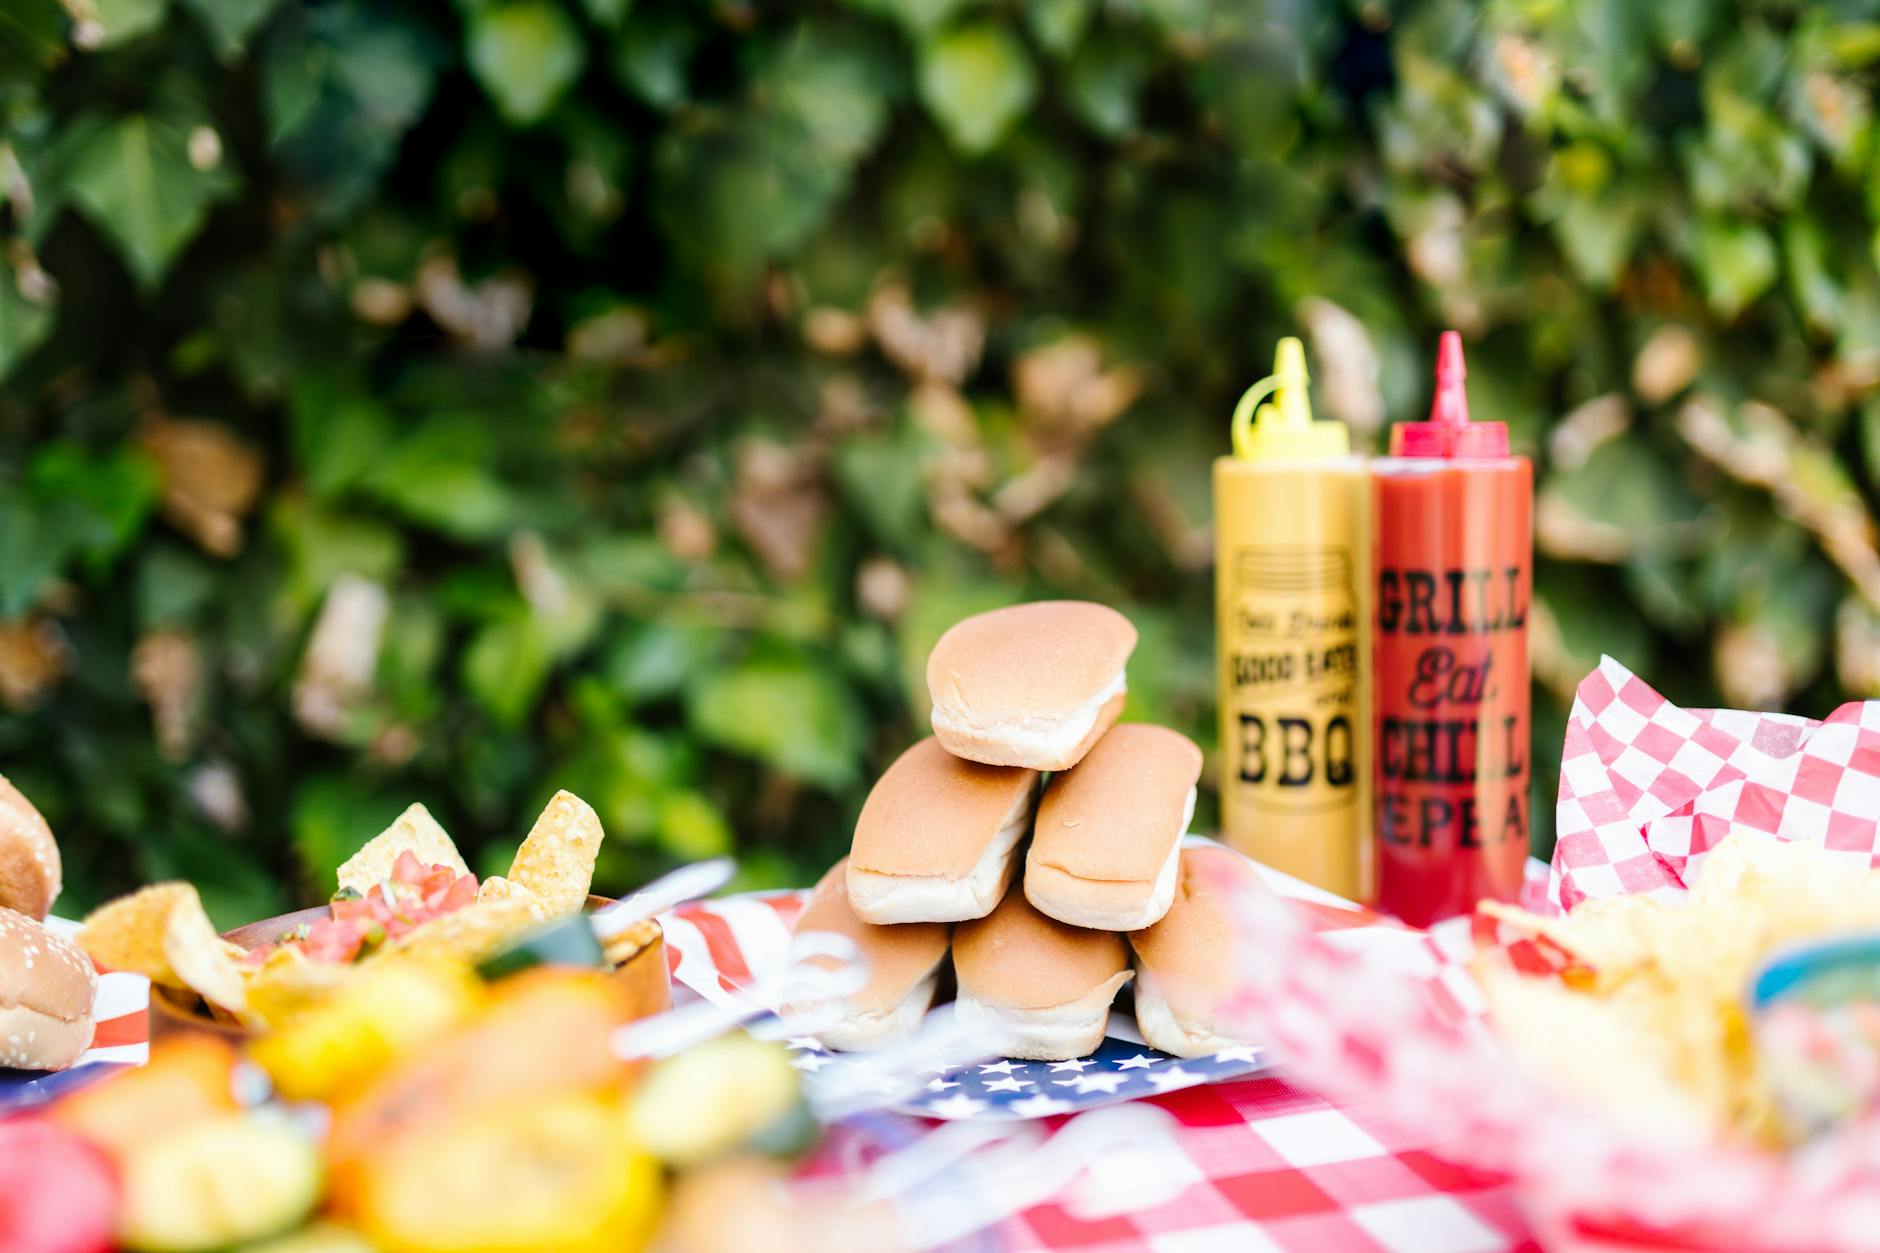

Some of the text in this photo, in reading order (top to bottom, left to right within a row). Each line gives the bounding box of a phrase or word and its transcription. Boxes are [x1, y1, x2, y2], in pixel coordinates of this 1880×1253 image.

[1379, 568, 1525, 635] GRILL
[1408, 646, 1498, 710] Eat
[1237, 712, 1354, 787] BBQ
[1379, 790, 1528, 847] EPEA
